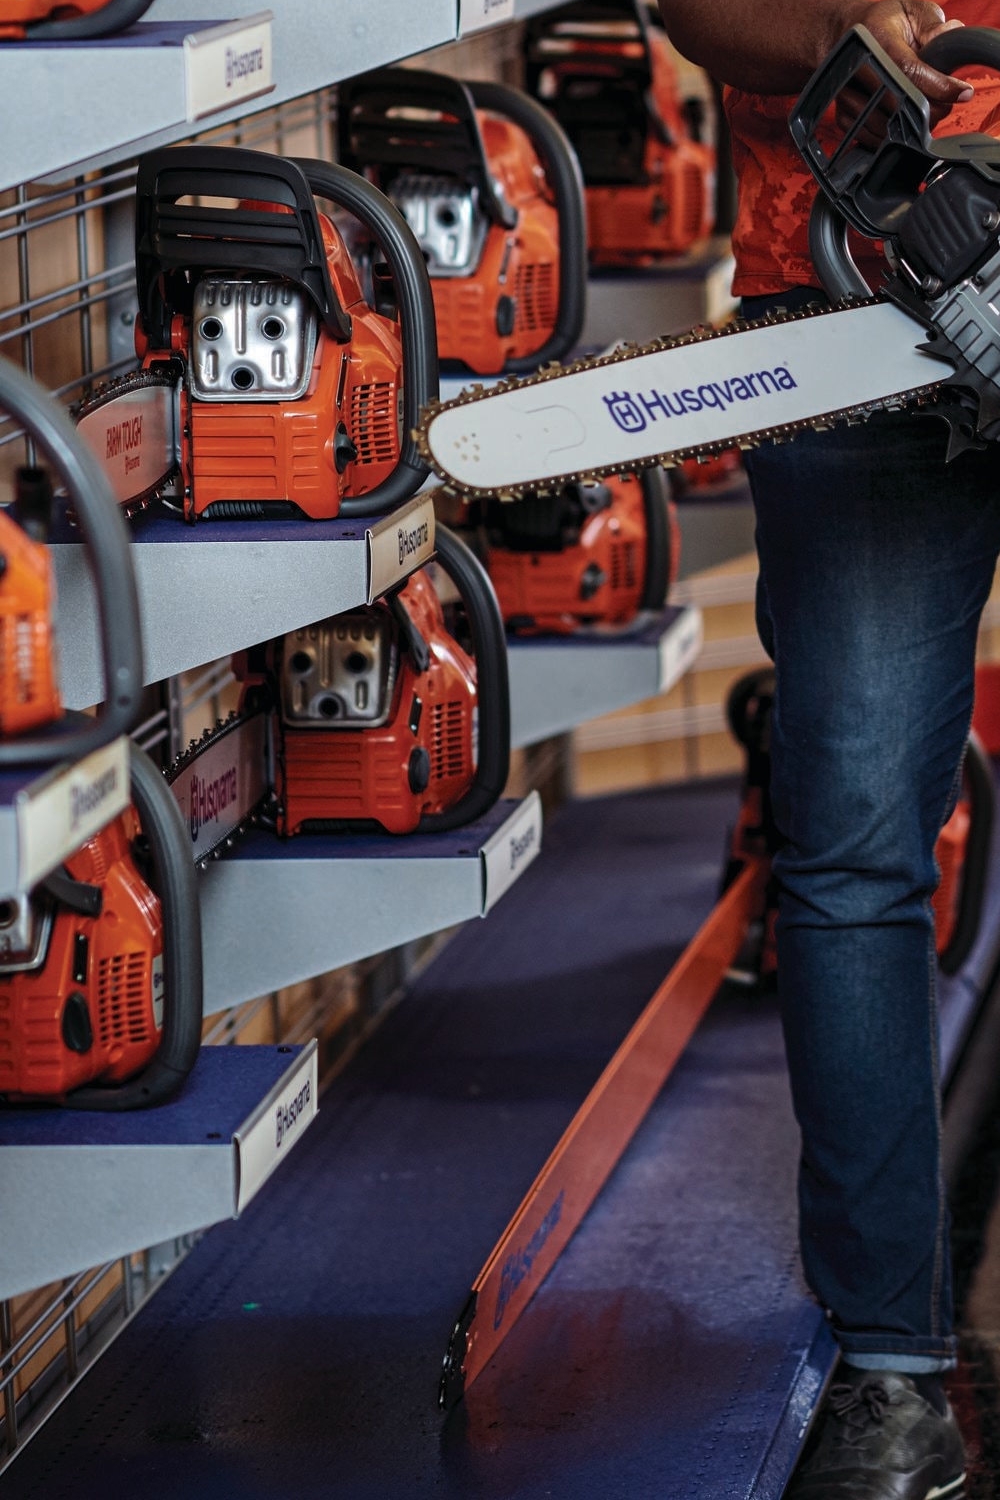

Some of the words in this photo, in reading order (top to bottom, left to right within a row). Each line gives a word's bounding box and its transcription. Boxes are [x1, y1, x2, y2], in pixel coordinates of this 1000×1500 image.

[636, 366, 798, 422] Husqvarna
[105, 423, 122, 460] FARM
[122, 414, 144, 453] TOUGH
[402, 521, 428, 558] Husqvarna
[199, 766, 237, 828] Husqvarna
[282, 1079, 310, 1137] Husqvarna
